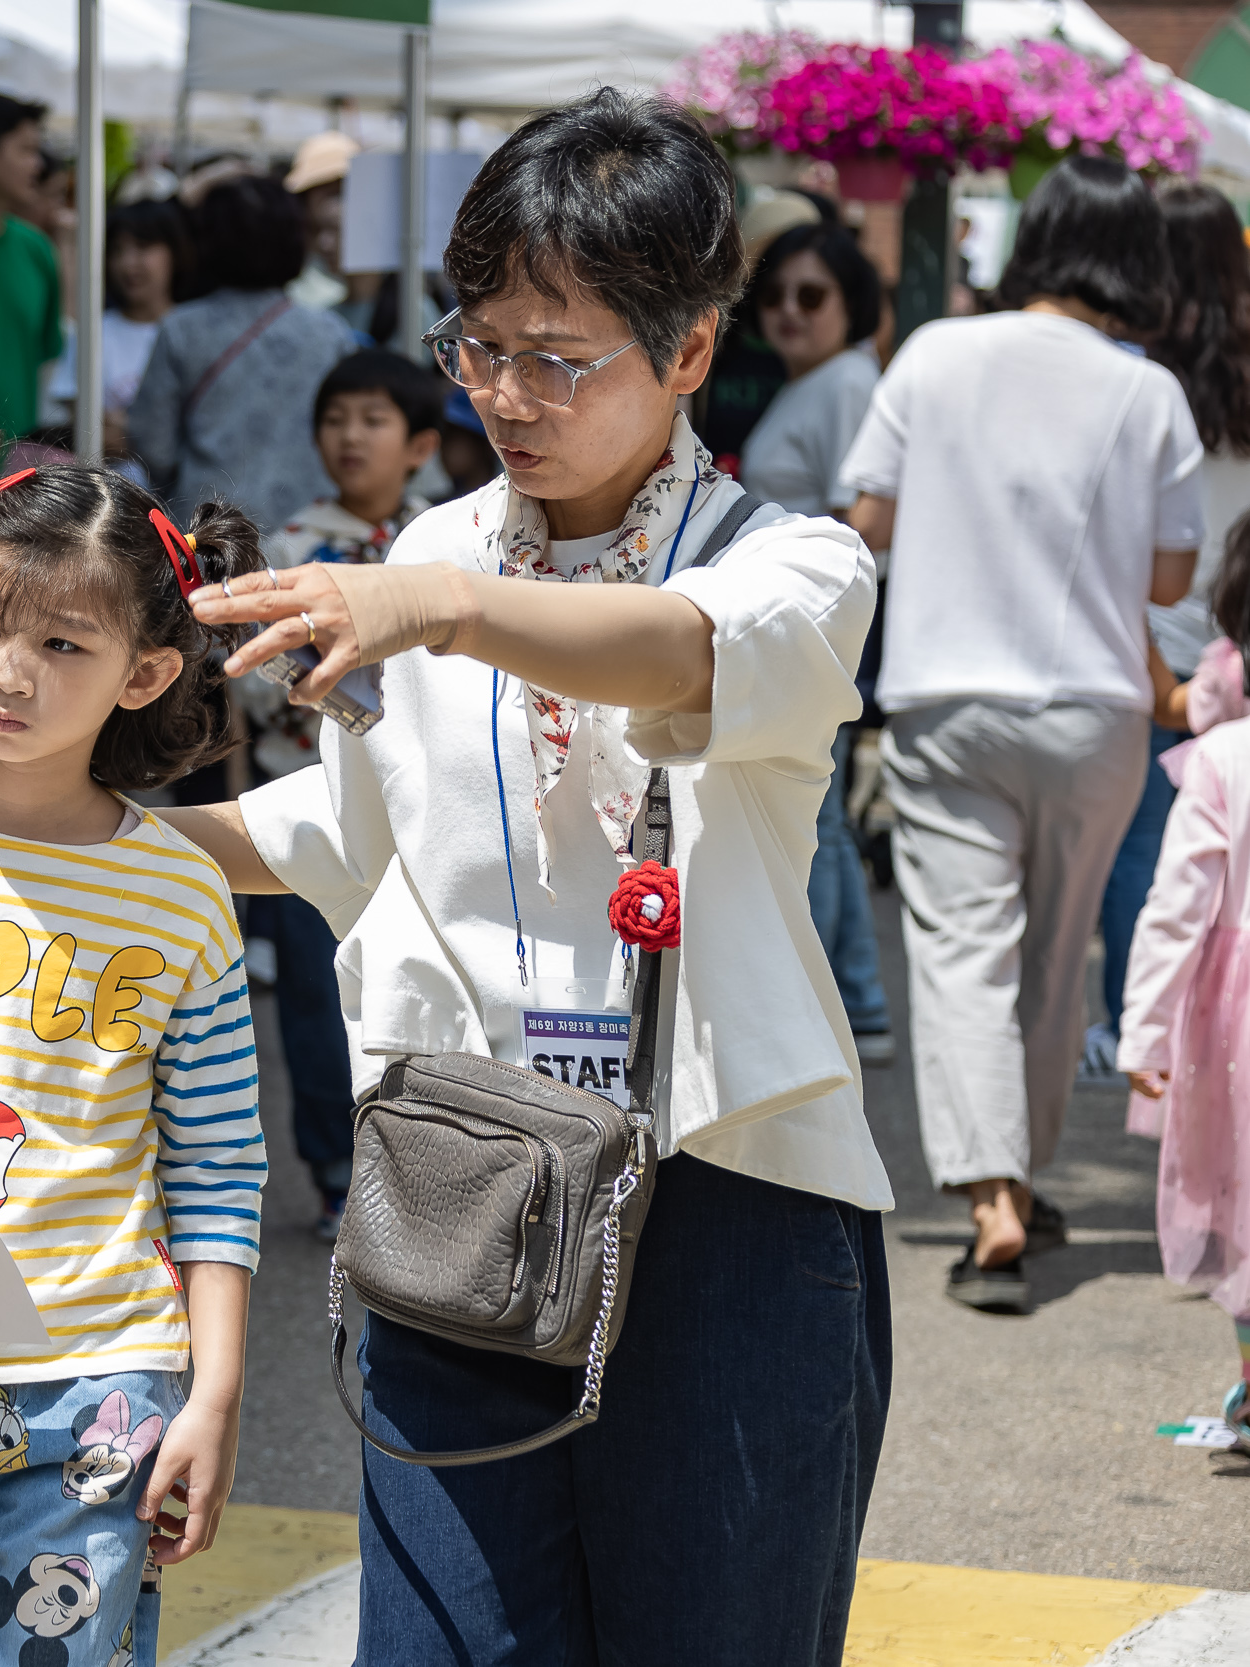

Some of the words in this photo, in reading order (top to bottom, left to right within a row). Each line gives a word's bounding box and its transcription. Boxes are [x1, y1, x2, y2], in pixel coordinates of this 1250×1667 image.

[527, 1019, 554, 1032] 제6회
[558, 1020, 595, 1033] 자양3동
[598, 1022, 631, 1035] 장미축
